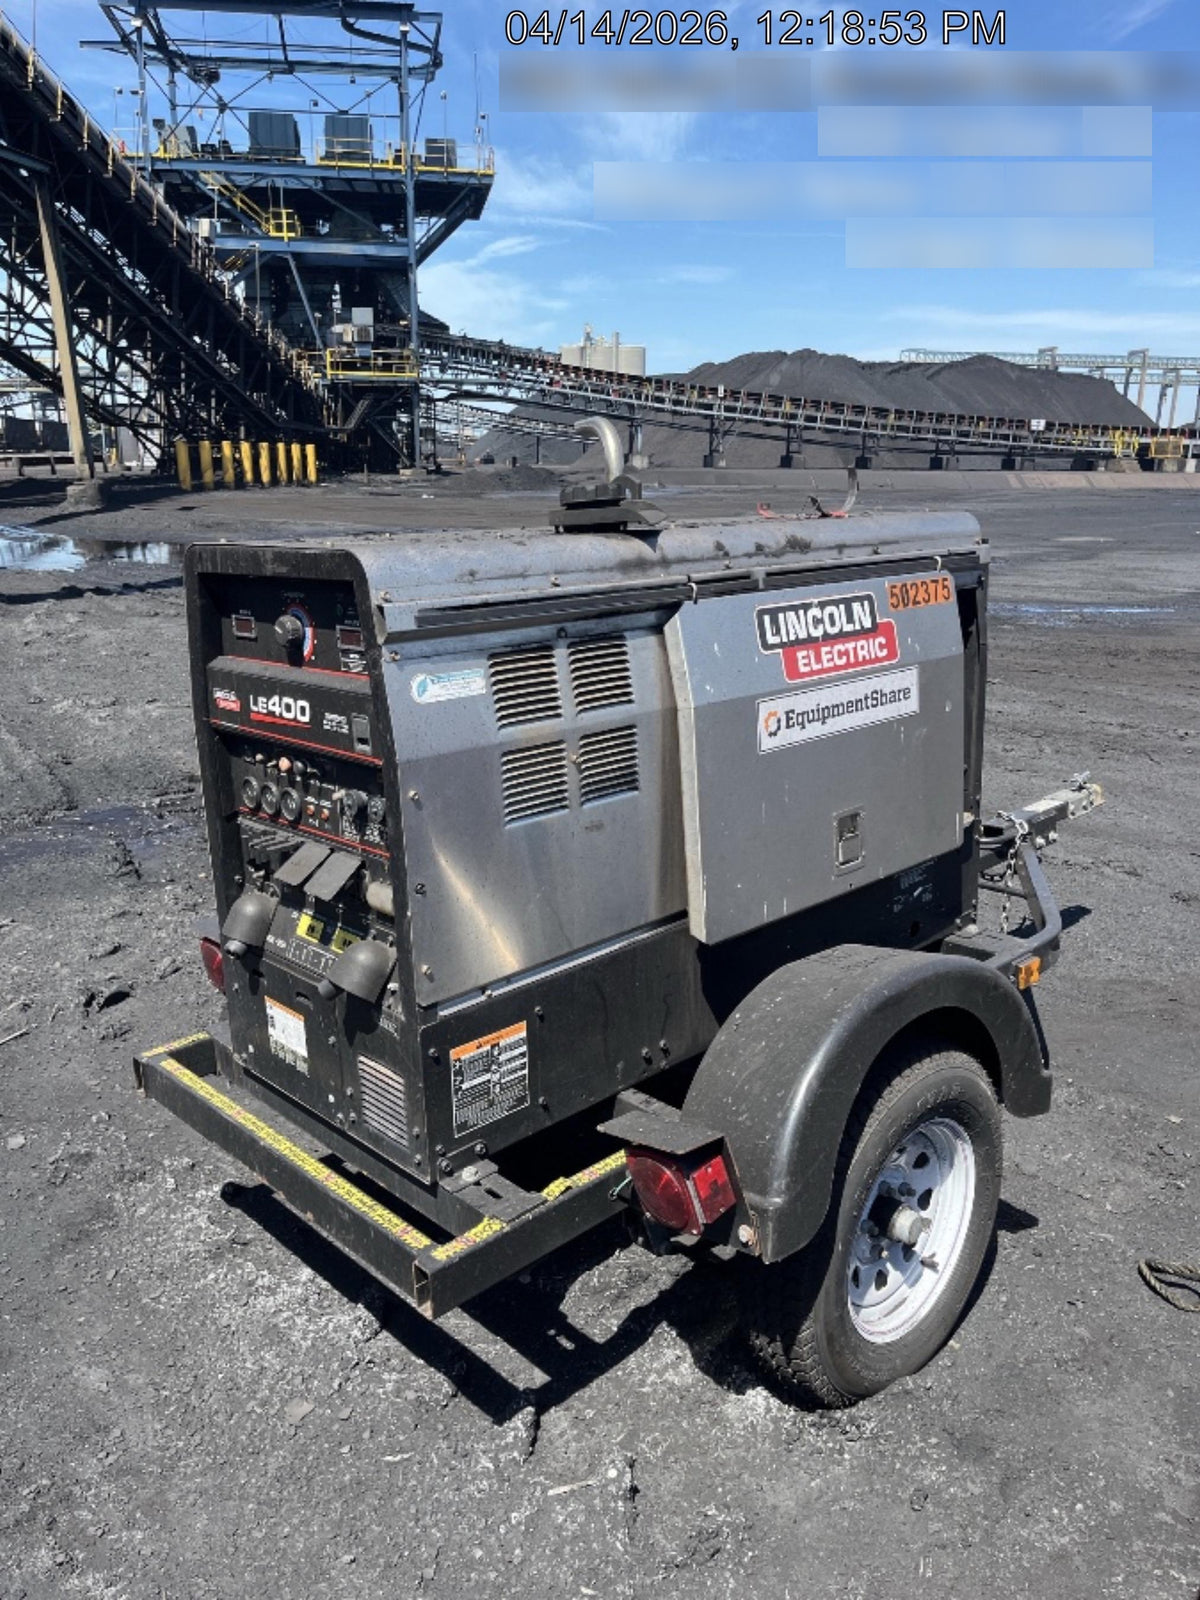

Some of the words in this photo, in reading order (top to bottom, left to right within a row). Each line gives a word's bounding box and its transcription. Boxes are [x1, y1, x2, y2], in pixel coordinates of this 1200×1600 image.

[890, 577, 952, 609] 502375
[762, 600, 872, 645] LINCOLN
[797, 636, 888, 673] ELECTRIC
[249, 694, 311, 723] LE400
[784, 685, 912, 730] EquipmentShare
